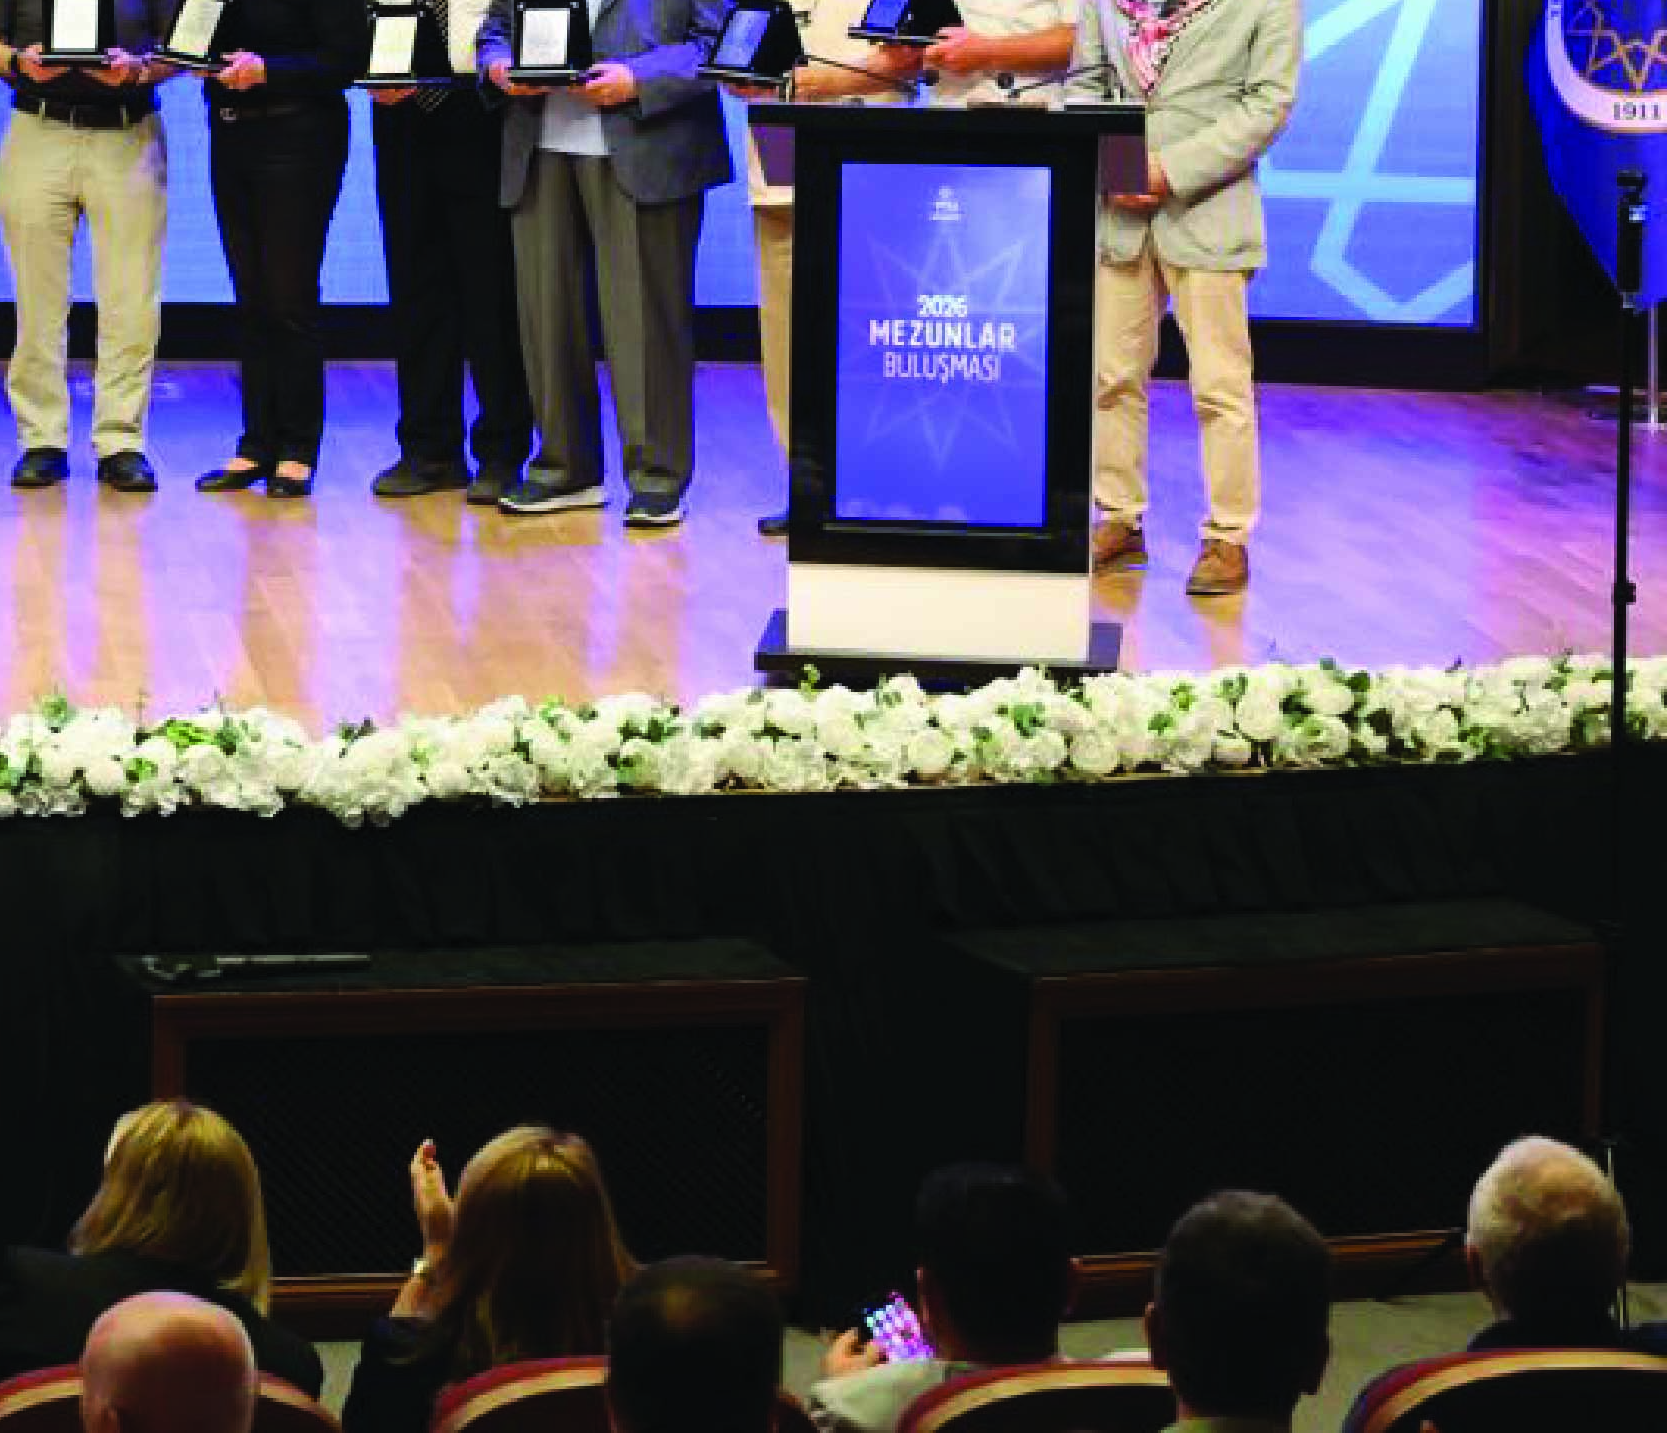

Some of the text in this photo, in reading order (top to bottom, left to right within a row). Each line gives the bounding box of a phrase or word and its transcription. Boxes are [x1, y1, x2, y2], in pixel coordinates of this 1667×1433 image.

[1613, 101, 1661, 121] 1911
[869, 319, 1016, 351] MEZUNLAR
[883, 352, 1001, 384] BULUŞMASI
